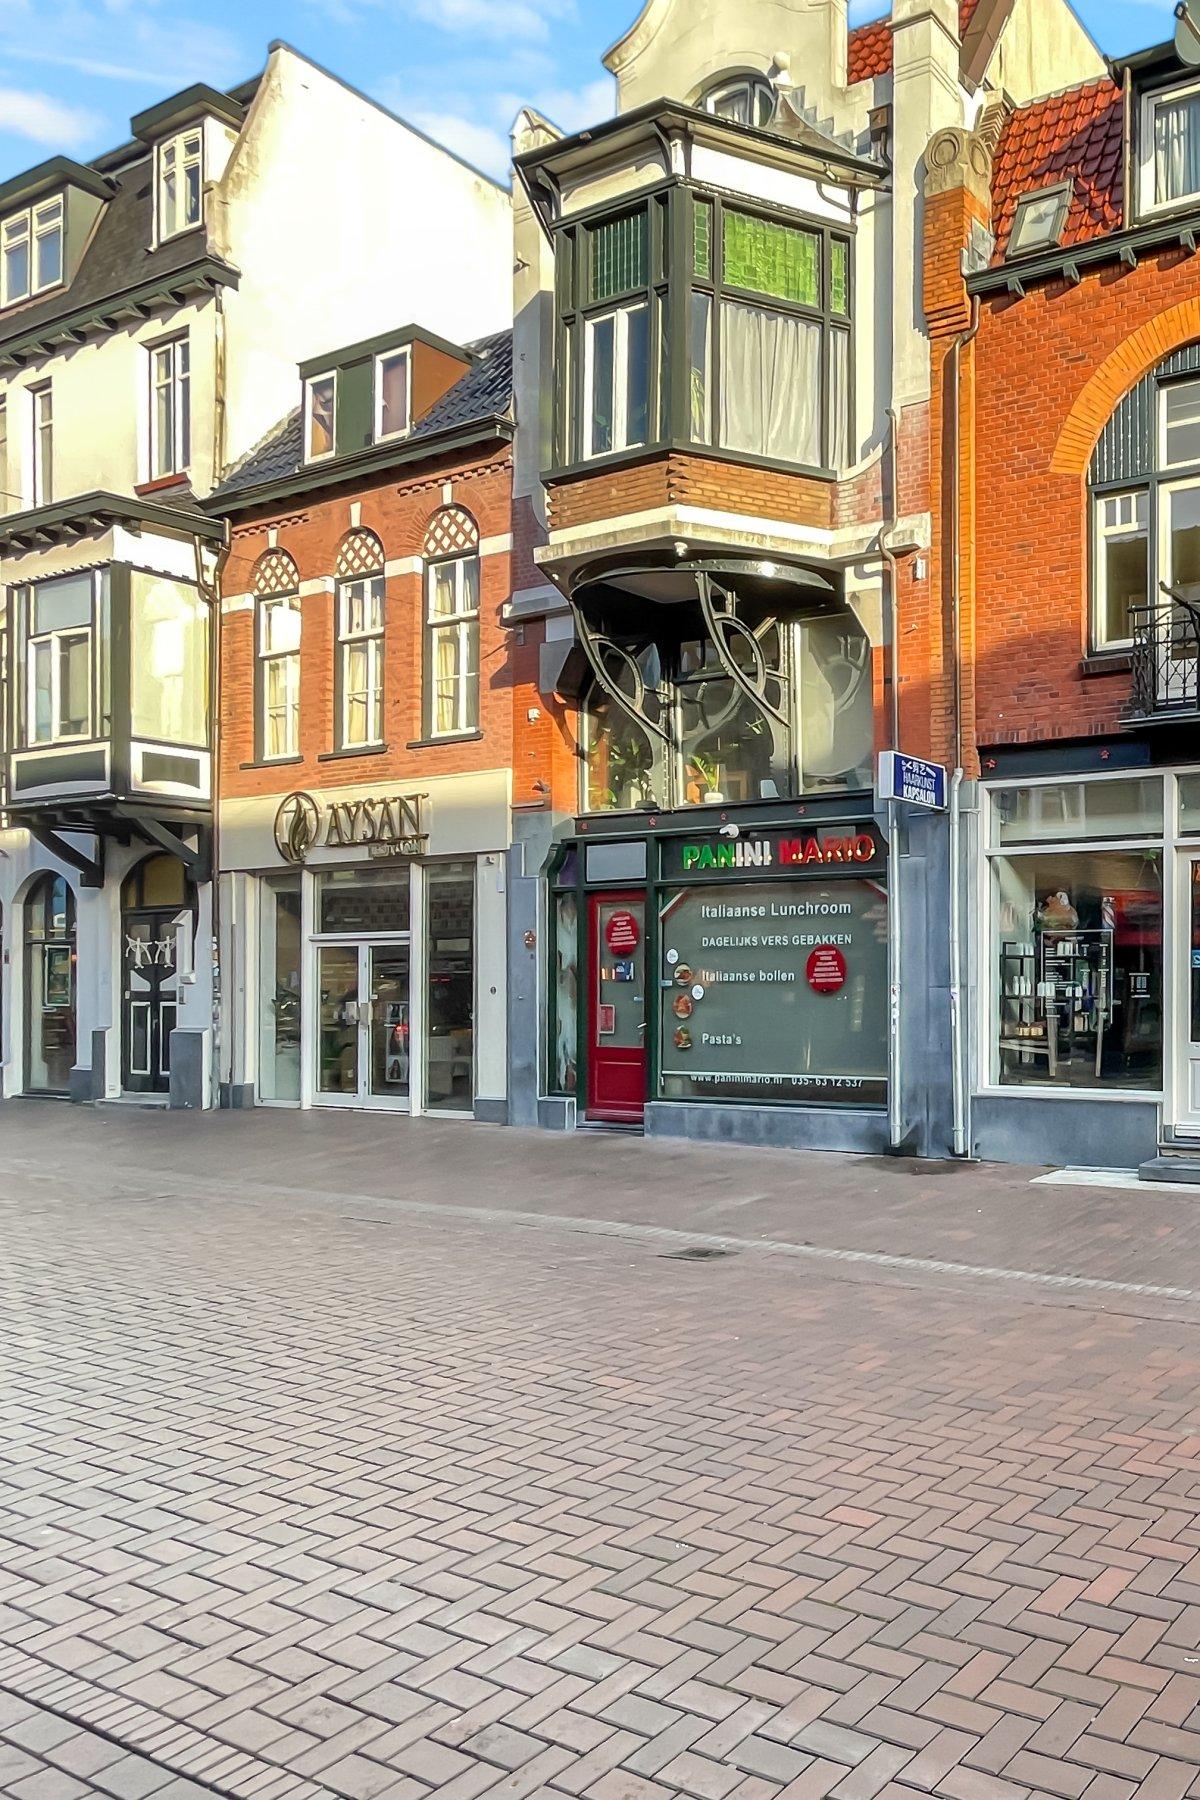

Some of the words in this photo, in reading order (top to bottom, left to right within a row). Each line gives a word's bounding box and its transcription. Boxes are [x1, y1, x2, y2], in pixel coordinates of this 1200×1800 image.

[903, 784, 936, 805] KAPSALON
[325, 792, 429, 847] AYSAN
[683, 841, 772, 870] PANINI
[779, 834, 875, 865] MARIO
[701, 904, 766, 918] Italiaanse
[771, 901, 852, 917] Lunchroom
[702, 936, 758, 947] DAGELIJKS
[761, 935, 789, 946] VERS
[792, 934, 852, 945] GEBAKKEN
[702, 970, 756, 981] Italiaanse
[759, 969, 795, 981] bollen
[702, 1033, 742, 1045] Pasta's
[815, 1078, 827, 1087] 63
[845, 1079, 863, 1088] 537
